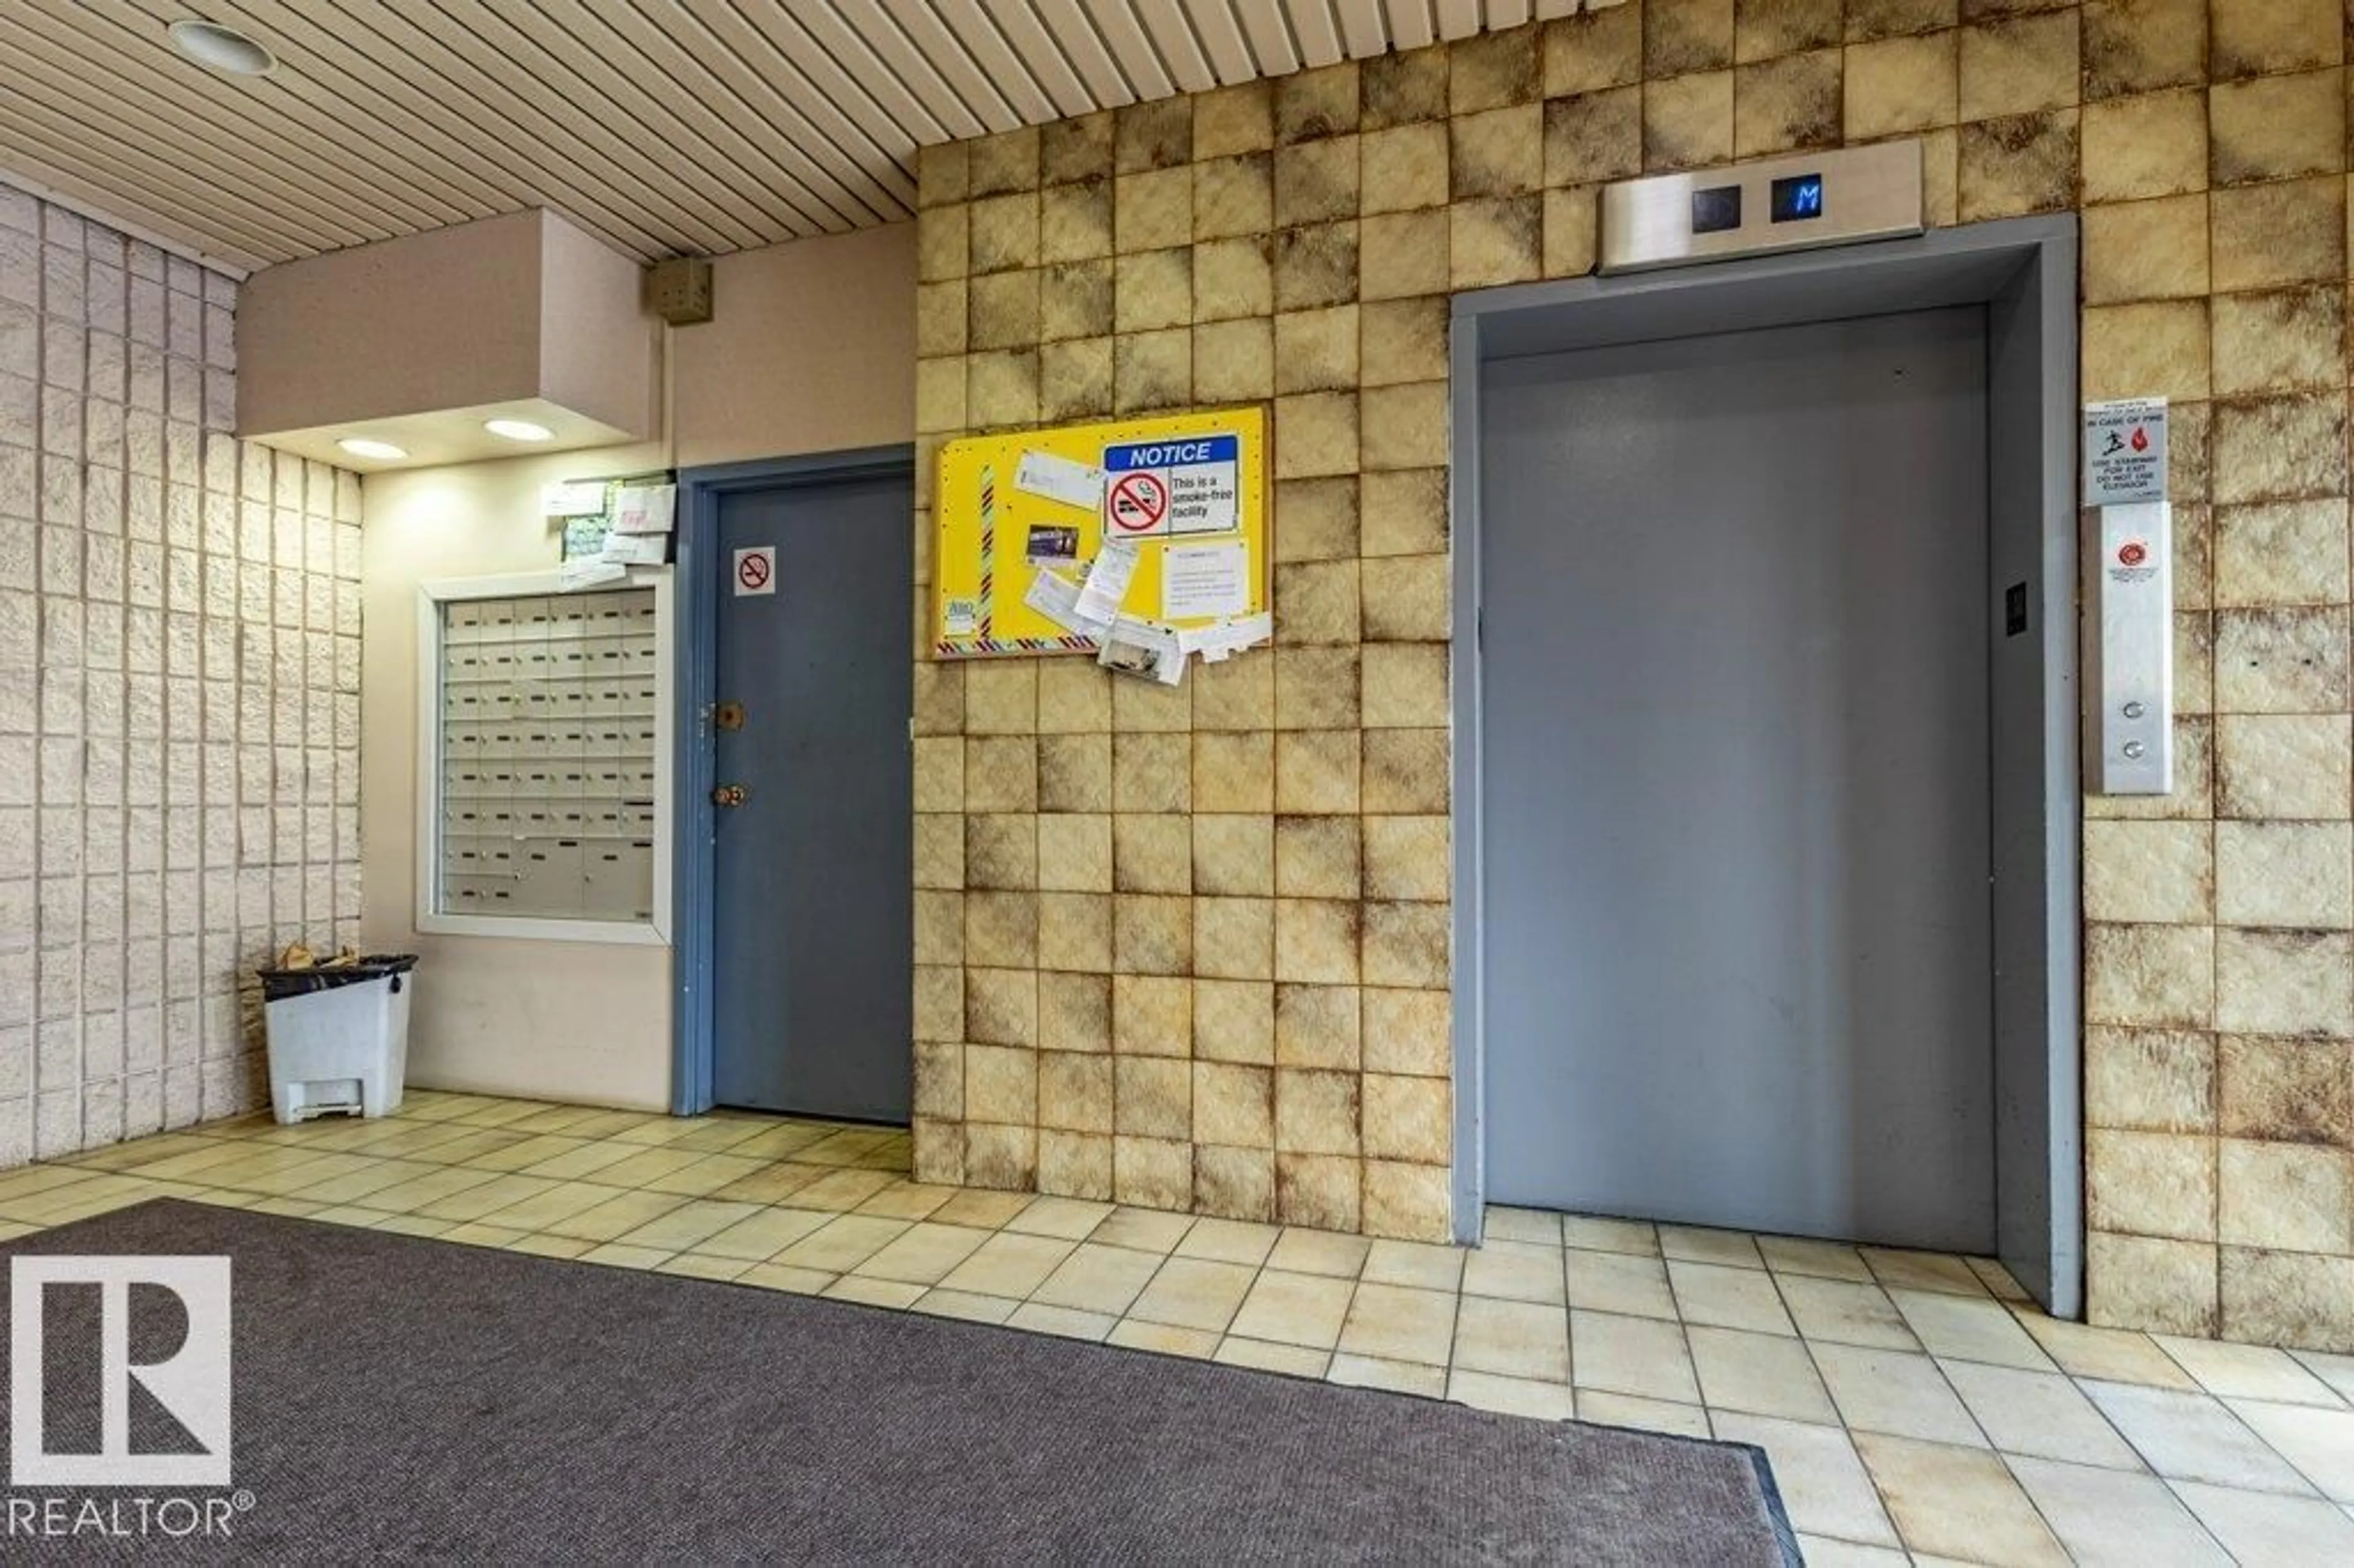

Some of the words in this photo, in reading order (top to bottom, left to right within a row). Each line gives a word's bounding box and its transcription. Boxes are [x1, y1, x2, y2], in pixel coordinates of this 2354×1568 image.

[1797, 185, 1819, 211] M
[2143, 413, 2164, 422] FIRE
[1130, 442, 1212, 466] NOTICE
[2125, 464, 2146, 473] EXIT
[1173, 478, 1194, 489] This
[1198, 476, 1207, 487] is
[1209, 478, 1217, 486] a
[1173, 491, 1233, 503] smoke-free
[1173, 506, 1208, 518] facility
